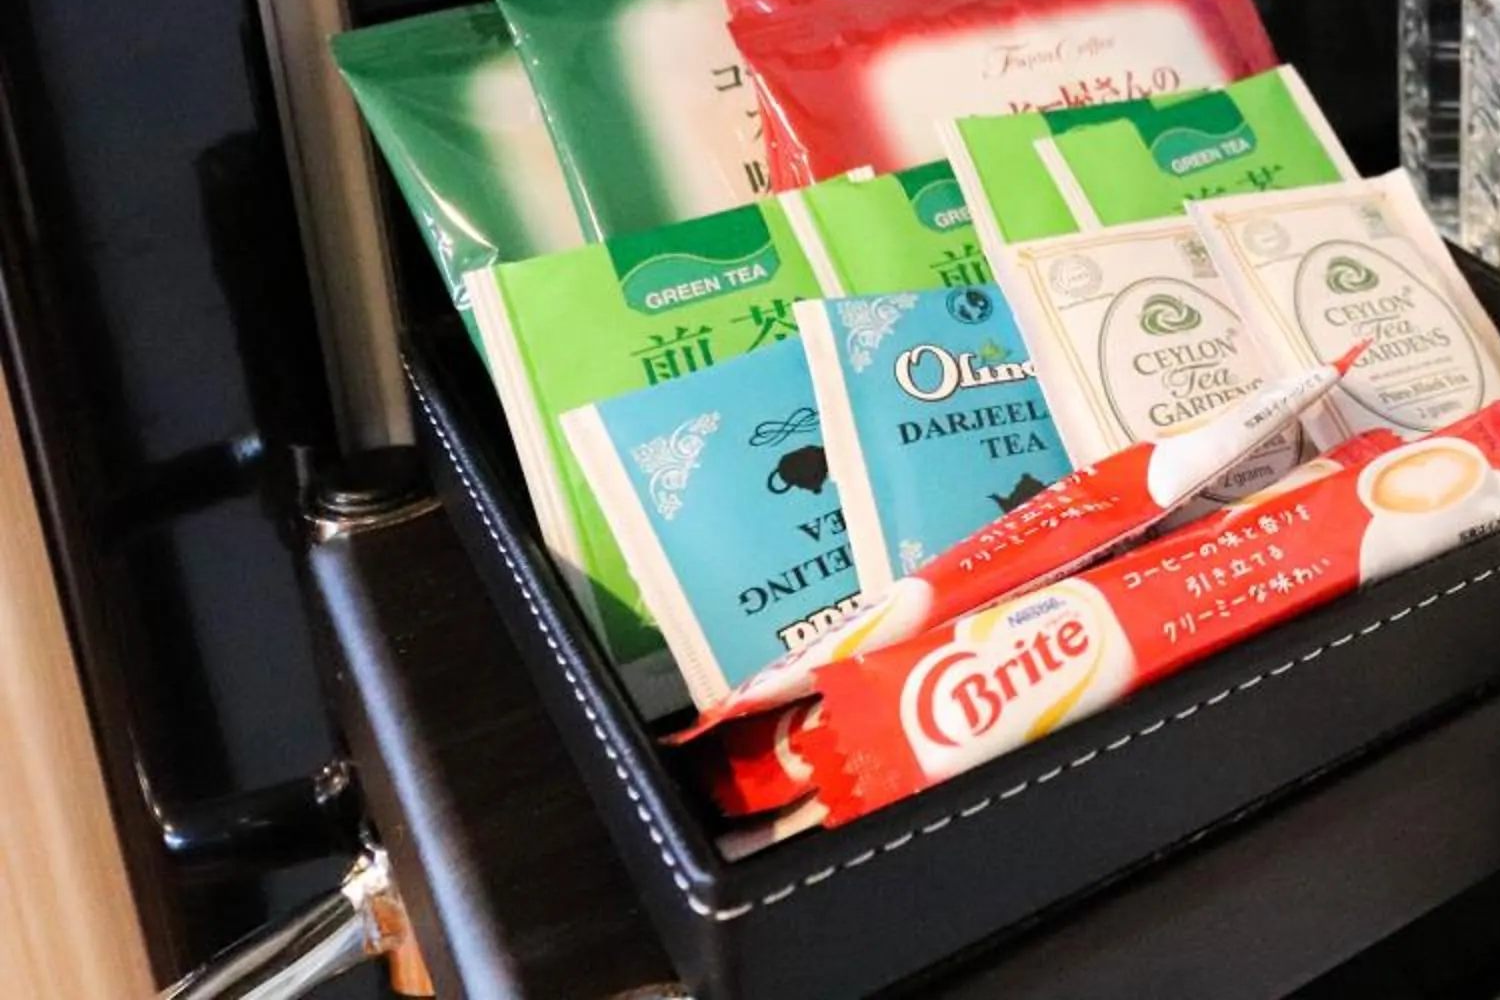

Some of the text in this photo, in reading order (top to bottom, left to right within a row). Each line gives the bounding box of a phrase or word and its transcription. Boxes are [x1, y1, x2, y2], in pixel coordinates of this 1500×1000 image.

[1171, 137, 1250, 174] GREEN TEA
[934, 205, 971, 228] GRE
[645, 263, 768, 309] GREEN TEA
[1324, 295, 1416, 327] CEYLON
[1132, 336, 1238, 376] CEYLON
[1162, 361, 1238, 399] Tea
[897, 400, 1049, 446] DARJEEL
[979, 431, 1049, 460] TEA
[1121, 503, 1311, 590] コーヒーの味と香りを
[1185, 543, 1284, 599] 引き立てる
[1162, 557, 1332, 644] クリーミーな味わい
[951, 620, 1090, 737] Brite
